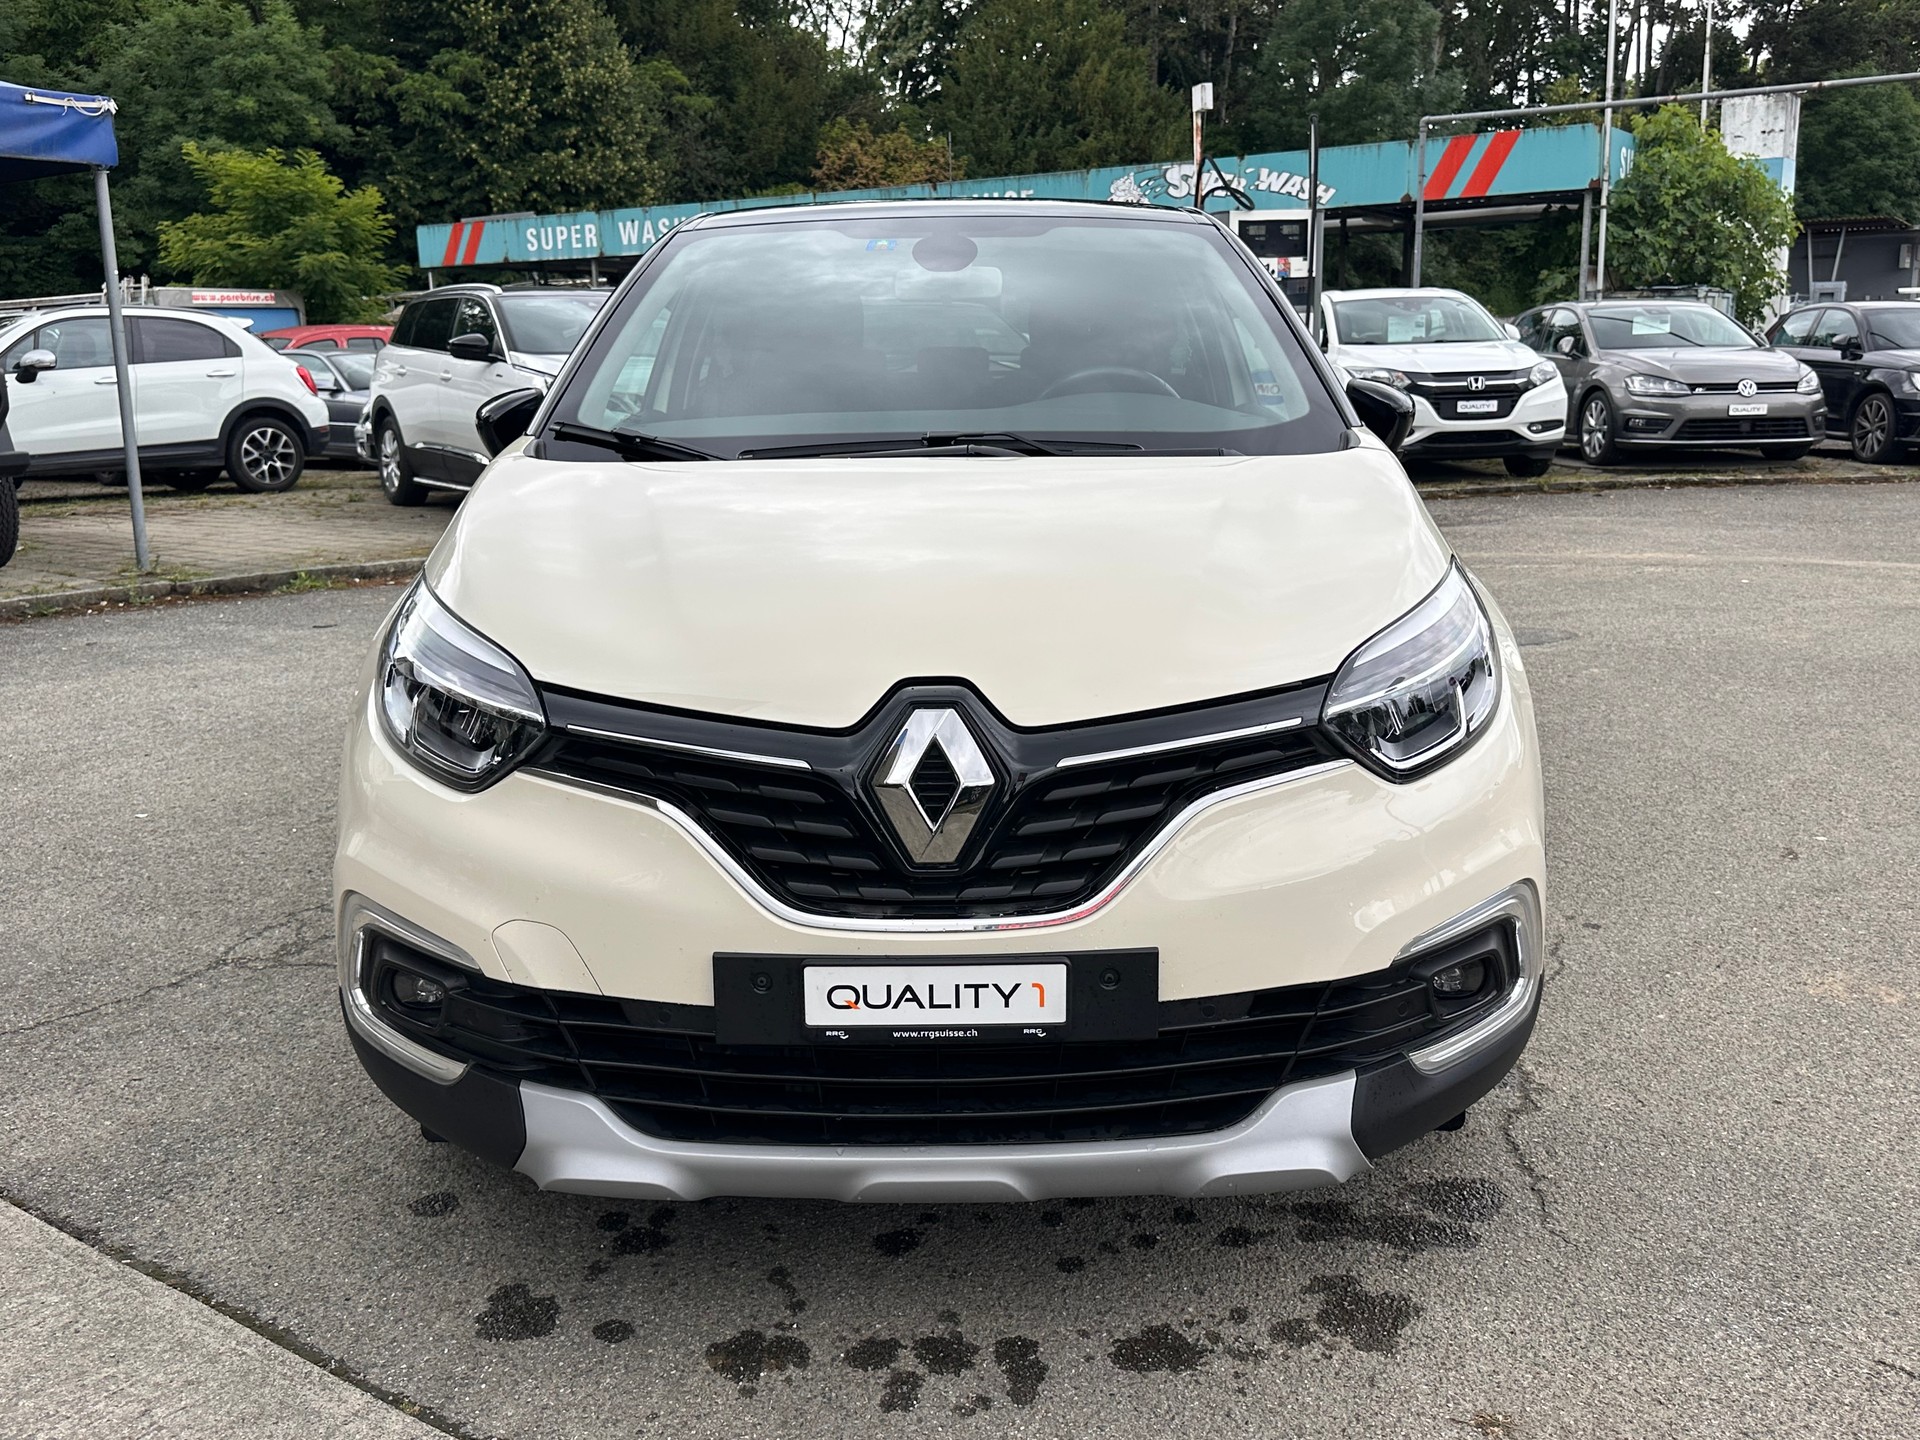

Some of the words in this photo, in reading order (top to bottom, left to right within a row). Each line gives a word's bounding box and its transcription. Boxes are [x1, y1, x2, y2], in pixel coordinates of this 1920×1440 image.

[1257, 167, 1337, 205] WASH
[526, 223, 598, 251] SUPER
[618, 216, 687, 246] WAS
[1731, 405, 1762, 413] QUALITY
[826, 983, 1022, 1010] QUALITY
[1031, 982, 1046, 1008] 1
[825, 1030, 848, 1039] RRG
[892, 1029, 979, 1040] www.rrgsuisse.ch
[1023, 1028, 1046, 1037] RRG
